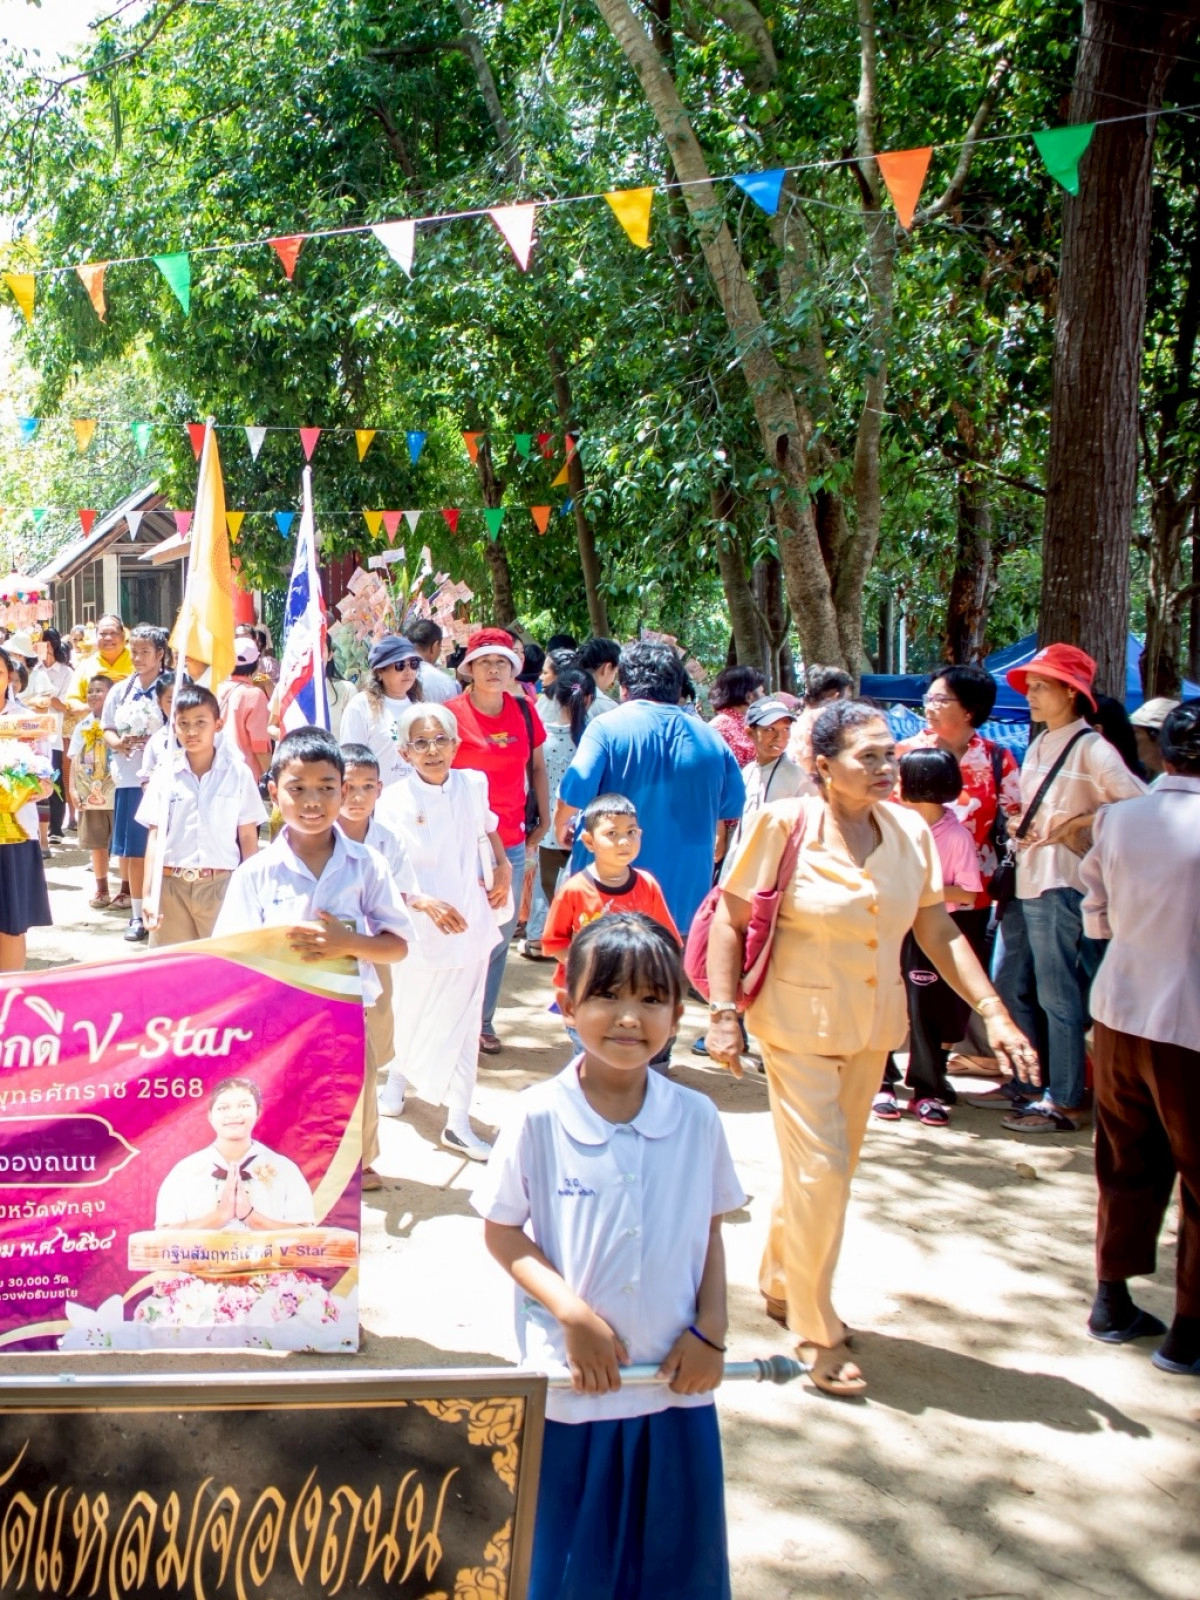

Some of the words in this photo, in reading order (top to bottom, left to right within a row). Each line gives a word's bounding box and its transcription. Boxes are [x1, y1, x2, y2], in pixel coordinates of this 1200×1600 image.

[72, 1012, 253, 1064] V-Star
[136, 1078, 204, 1100] 2568
[8, 1276, 50, 1288] 30,000
[53, 1274, 69, 1284] วัด
